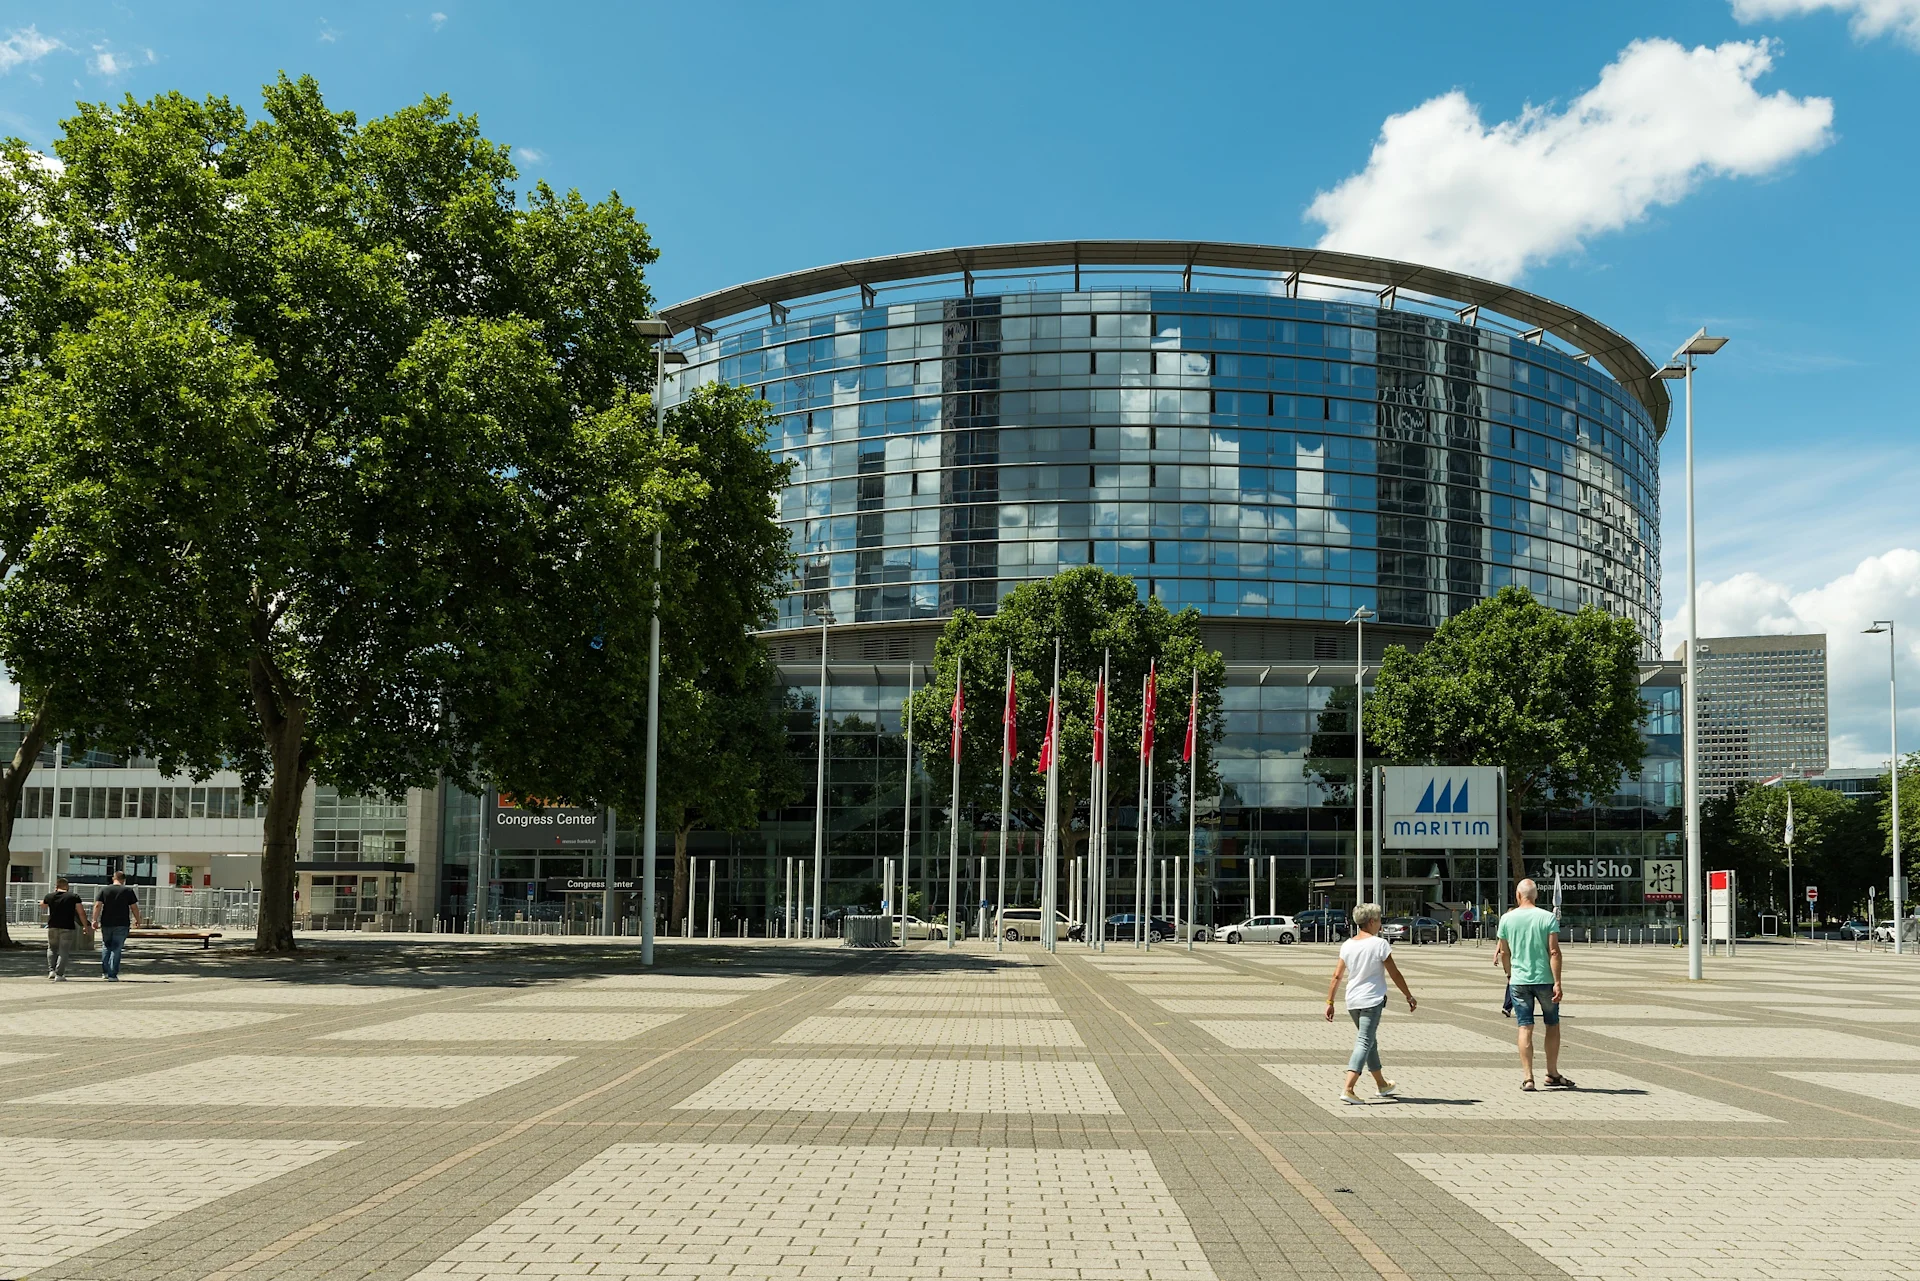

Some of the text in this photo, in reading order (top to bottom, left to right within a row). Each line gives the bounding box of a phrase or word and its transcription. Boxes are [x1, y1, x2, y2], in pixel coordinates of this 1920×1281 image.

[497, 813, 597, 827] Congress Center
[1394, 821, 1489, 835] MARITIM
[567, 880, 605, 889] Congress
